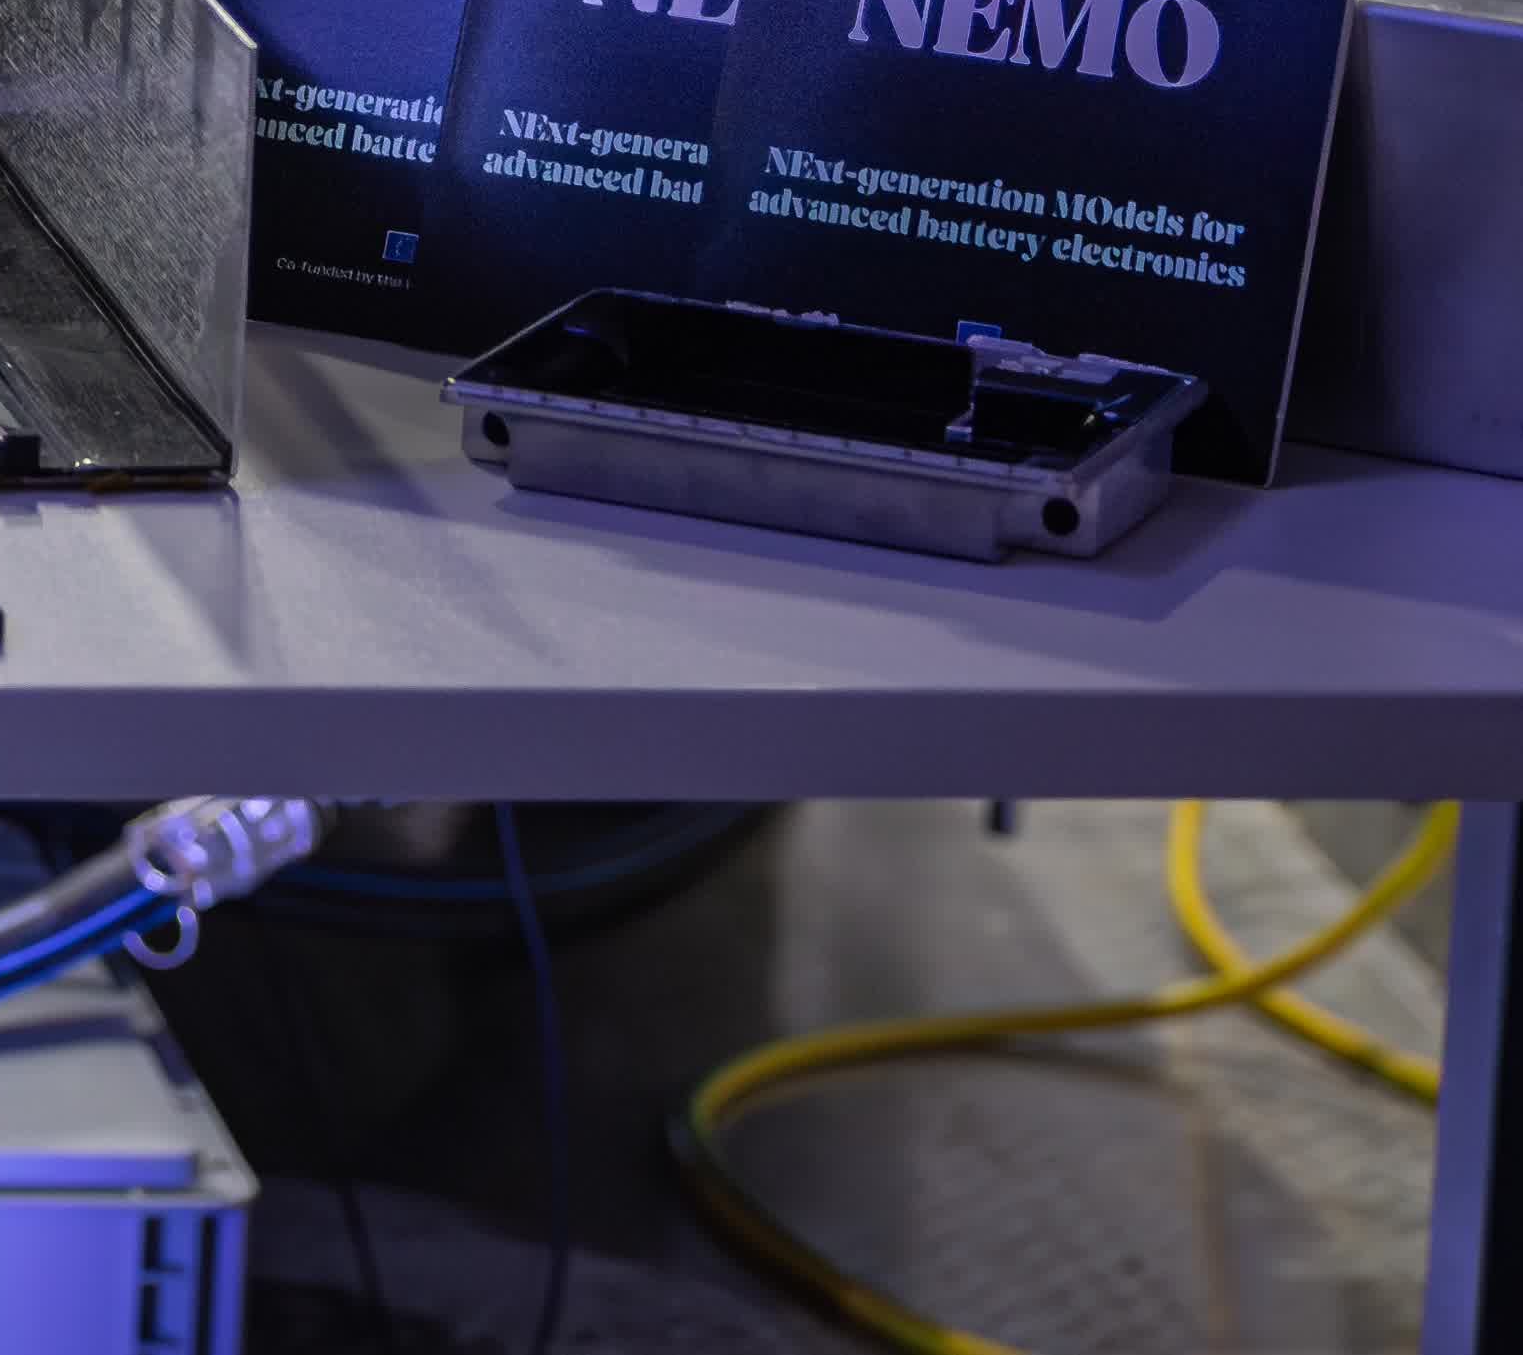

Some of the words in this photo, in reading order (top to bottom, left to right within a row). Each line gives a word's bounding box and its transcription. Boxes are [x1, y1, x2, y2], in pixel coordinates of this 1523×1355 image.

[482, 149, 645, 196] advanced
[499, 108, 709, 166] NExt-genera
[763, 145, 1046, 216] NExt-generation
[1052, 189, 1185, 237] MOdels
[1191, 211, 1246, 246] for
[749, 187, 912, 236] advanced
[917, 209, 1046, 262] battery
[1052, 233, 1247, 288] electronics
